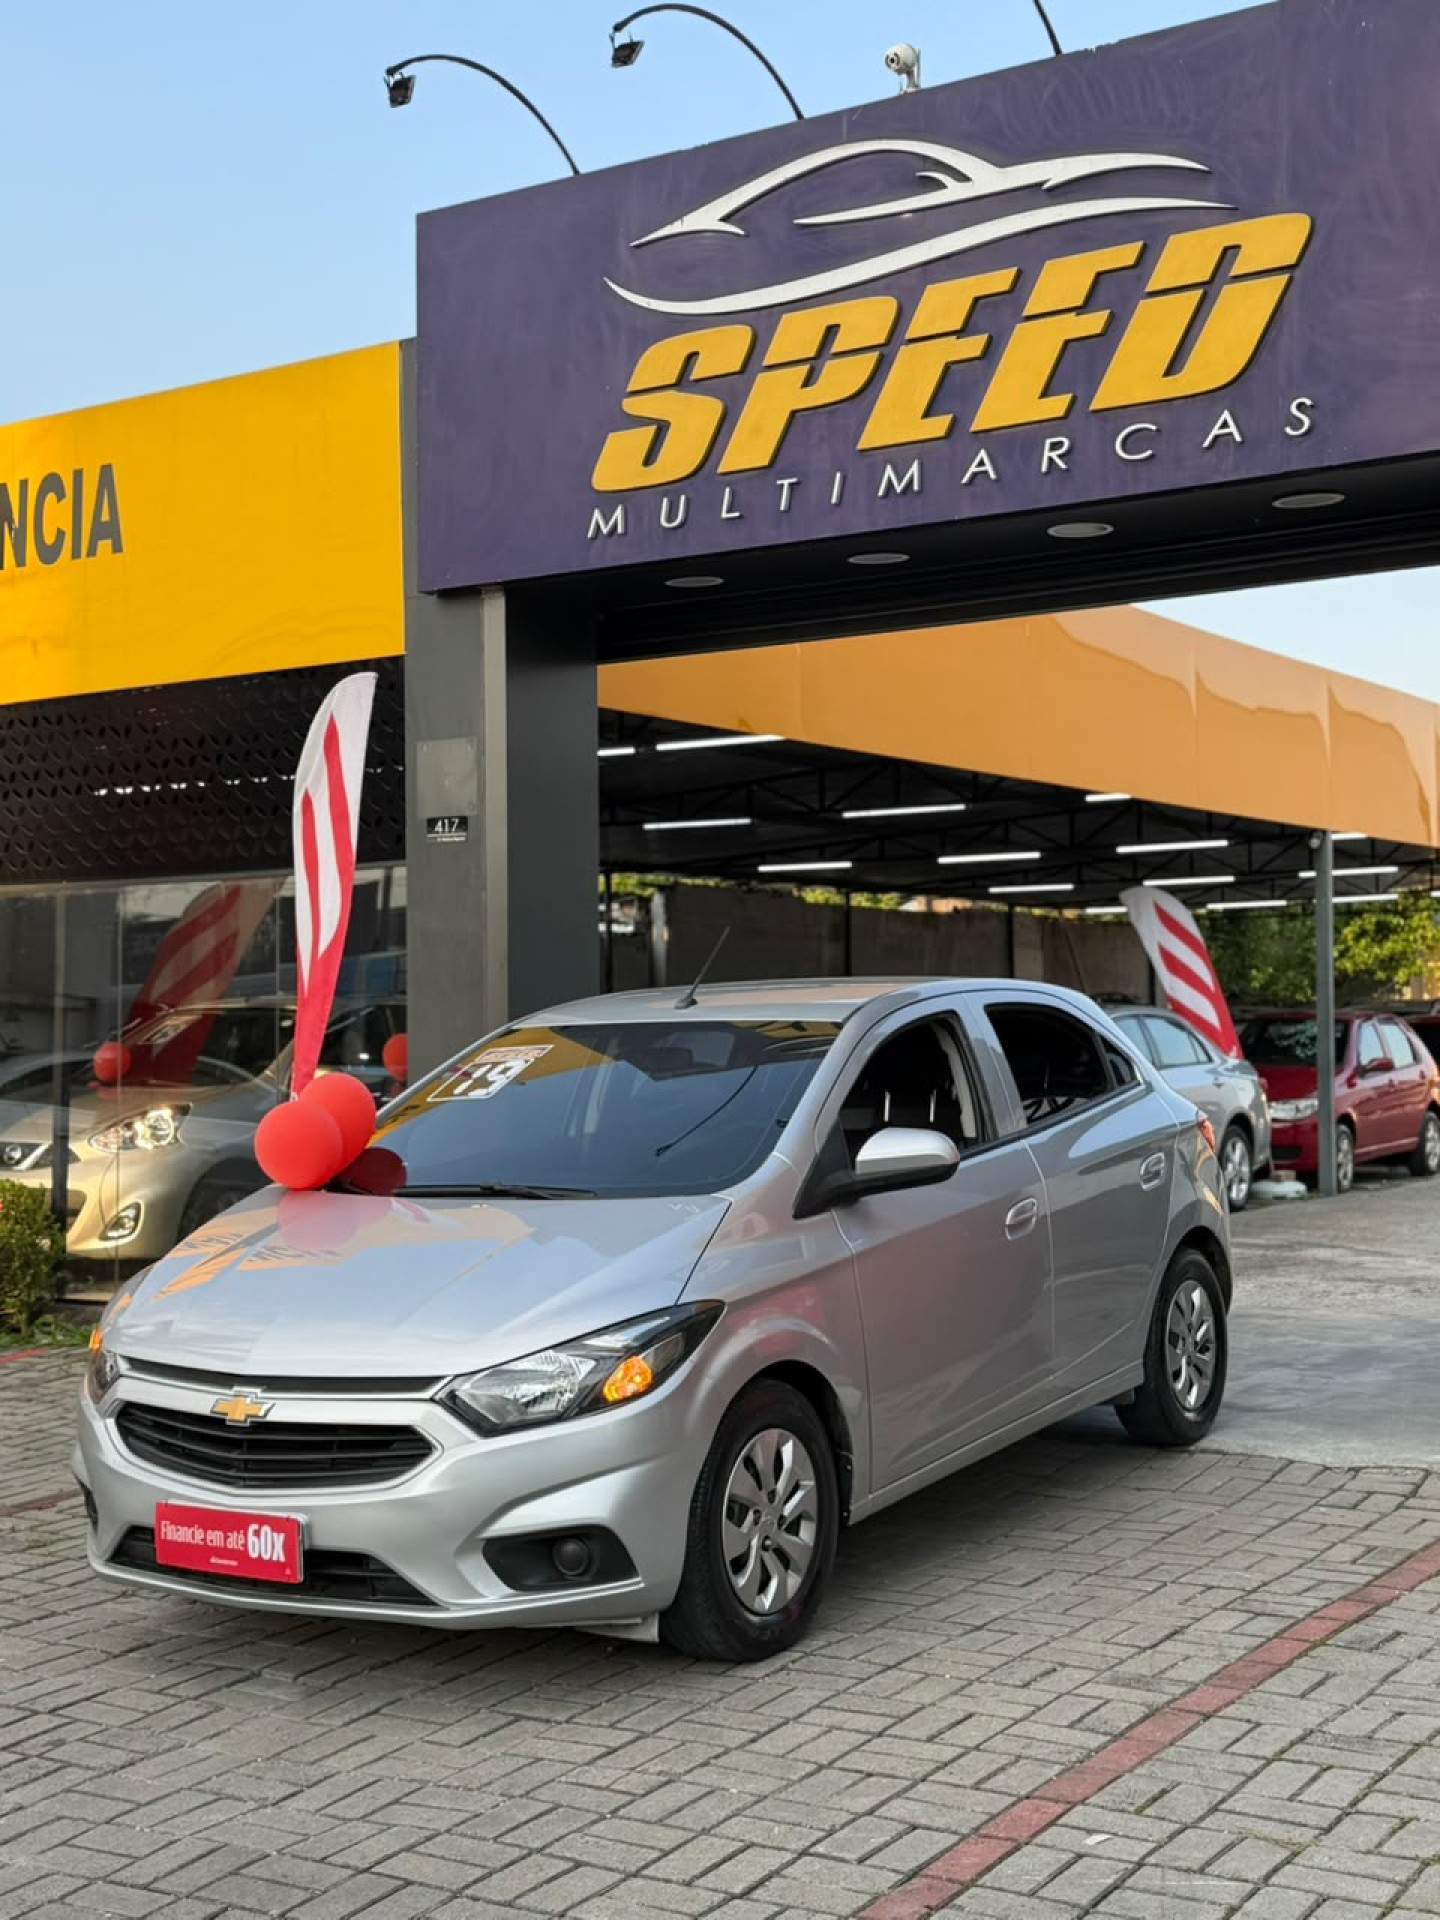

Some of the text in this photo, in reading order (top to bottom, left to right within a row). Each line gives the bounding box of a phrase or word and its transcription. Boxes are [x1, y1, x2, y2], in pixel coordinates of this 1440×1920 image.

[590, 213, 1312, 492] SPEED
[587, 398, 1315, 538] MULTIMARCAS
[434, 818, 460, 832] 417
[160, 1520, 205, 1545] Financie
[206, 1529, 225, 1548] em
[226, 1529, 246, 1550] até
[247, 1523, 286, 1563] 60x
